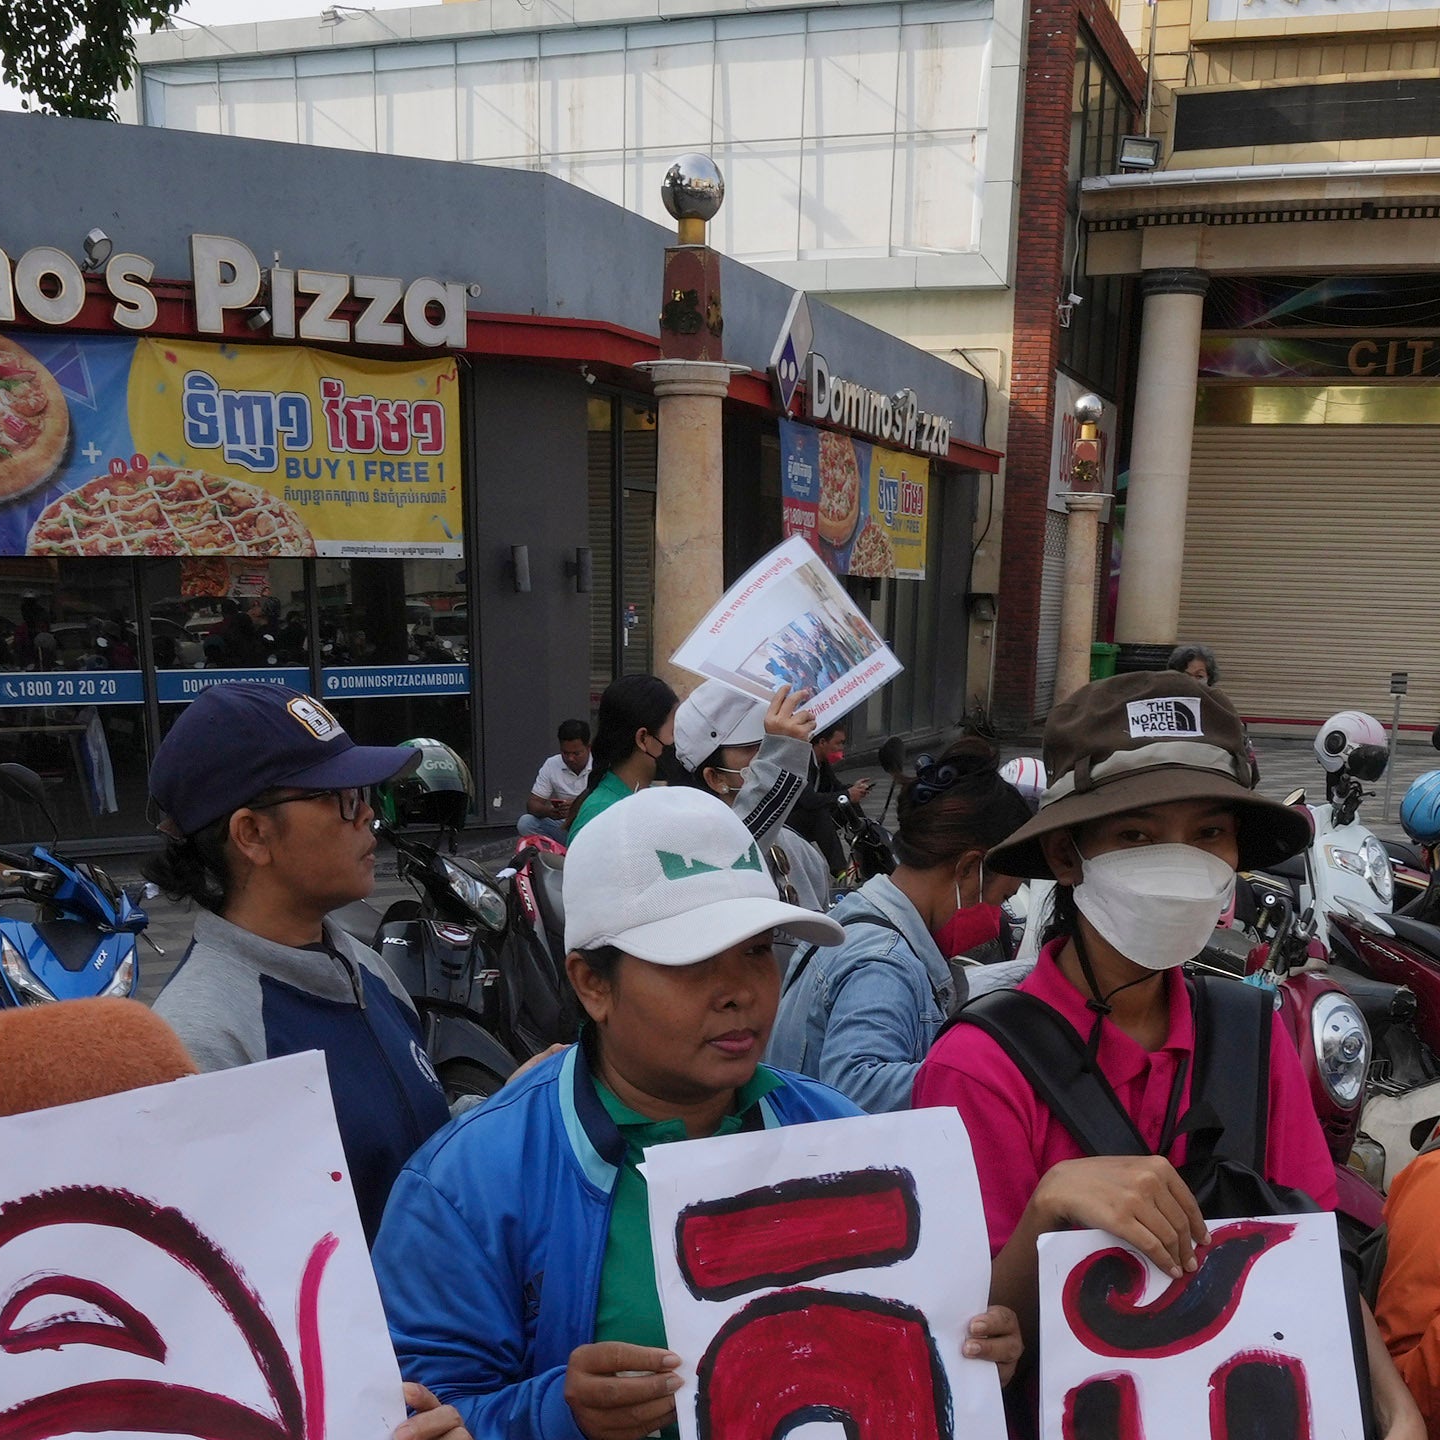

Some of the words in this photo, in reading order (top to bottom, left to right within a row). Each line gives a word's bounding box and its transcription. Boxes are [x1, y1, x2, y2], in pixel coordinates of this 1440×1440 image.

[189, 232, 469, 349] Pizza
[806, 352, 904, 441] Dominos
[285, 457, 341, 480] BUY
[347, 459, 356, 480] 1
[364, 460, 430, 483] FREE
[437, 462, 445, 482] 1
[18, 680, 52, 697] 1800
[57, 681, 74, 696] 20
[79, 680, 95, 696] 20
[100, 679, 117, 695] 20
[341, 673, 465, 689] DOMINOSPIZZACAMBODIA
[1147, 701, 1173, 712] THE
[1131, 712, 1173, 726] NORTH
[1142, 721, 1176, 732] FACE
[423, 758, 454, 771] Grab
[93, 949, 109, 970] NCX
